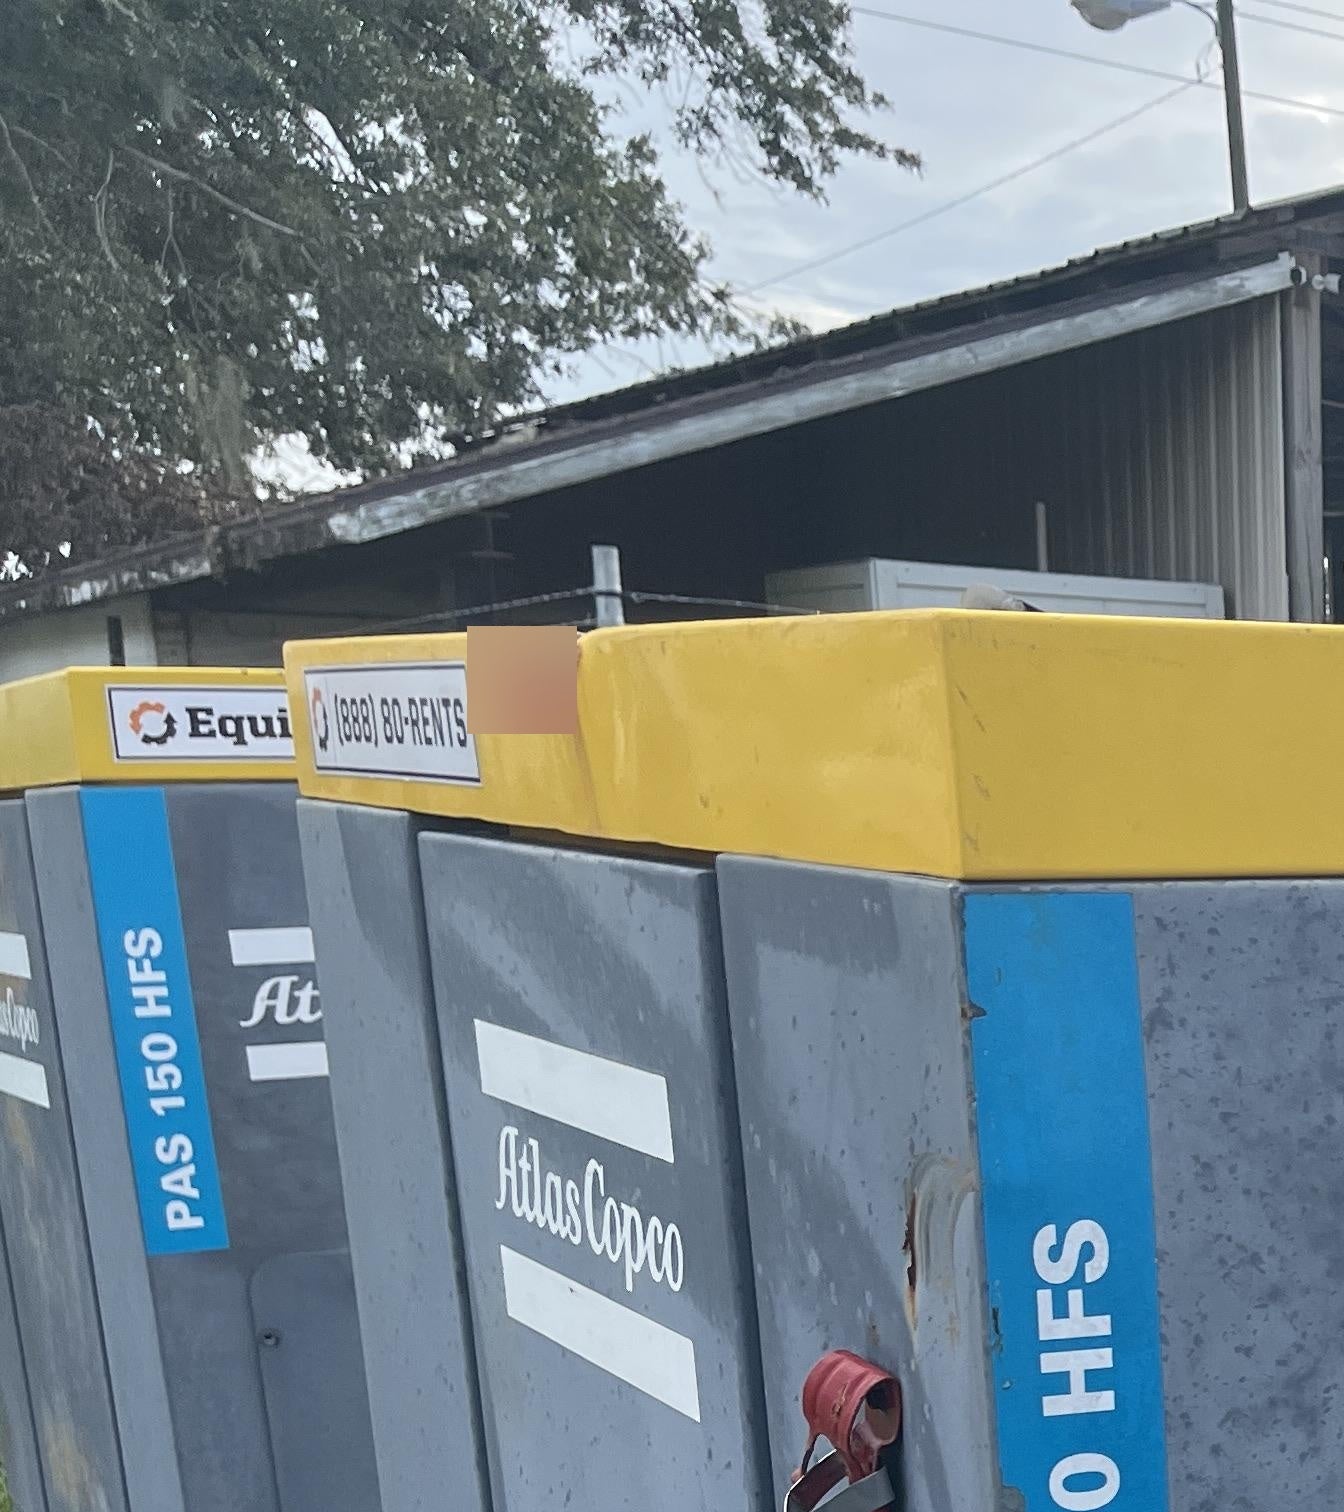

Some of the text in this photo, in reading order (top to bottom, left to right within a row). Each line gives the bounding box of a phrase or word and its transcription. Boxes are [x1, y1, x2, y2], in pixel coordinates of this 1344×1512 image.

[334, 692, 468, 748] (888) 80-RENTS
[123, 926, 204, 1231] PAS 150 HFS
[496, 1125, 684, 1293] Atlas Copco
[1032, 1217, 1117, 1417] HFS
